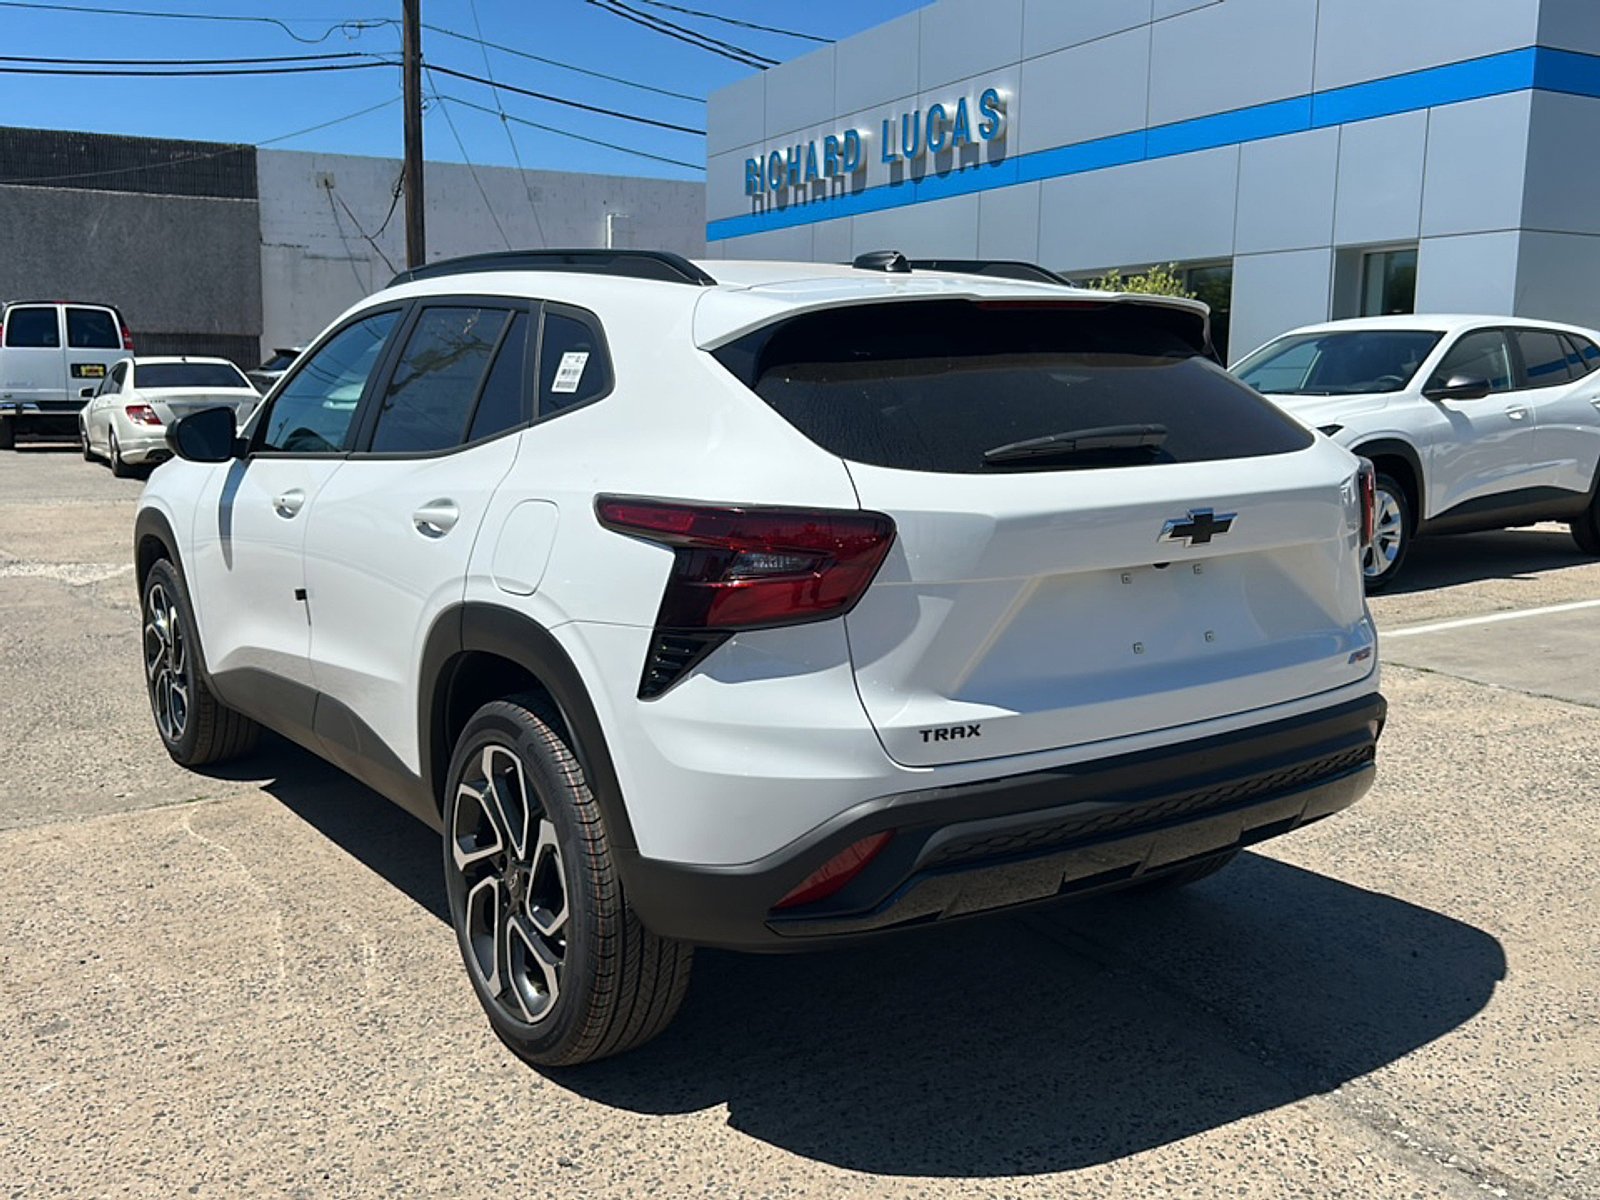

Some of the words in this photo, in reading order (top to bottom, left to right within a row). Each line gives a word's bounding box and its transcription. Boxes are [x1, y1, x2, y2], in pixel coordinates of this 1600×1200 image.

[745, 129, 862, 195] RICHARD
[881, 88, 1000, 164] LUCAS
[919, 724, 981, 742] TRAX
